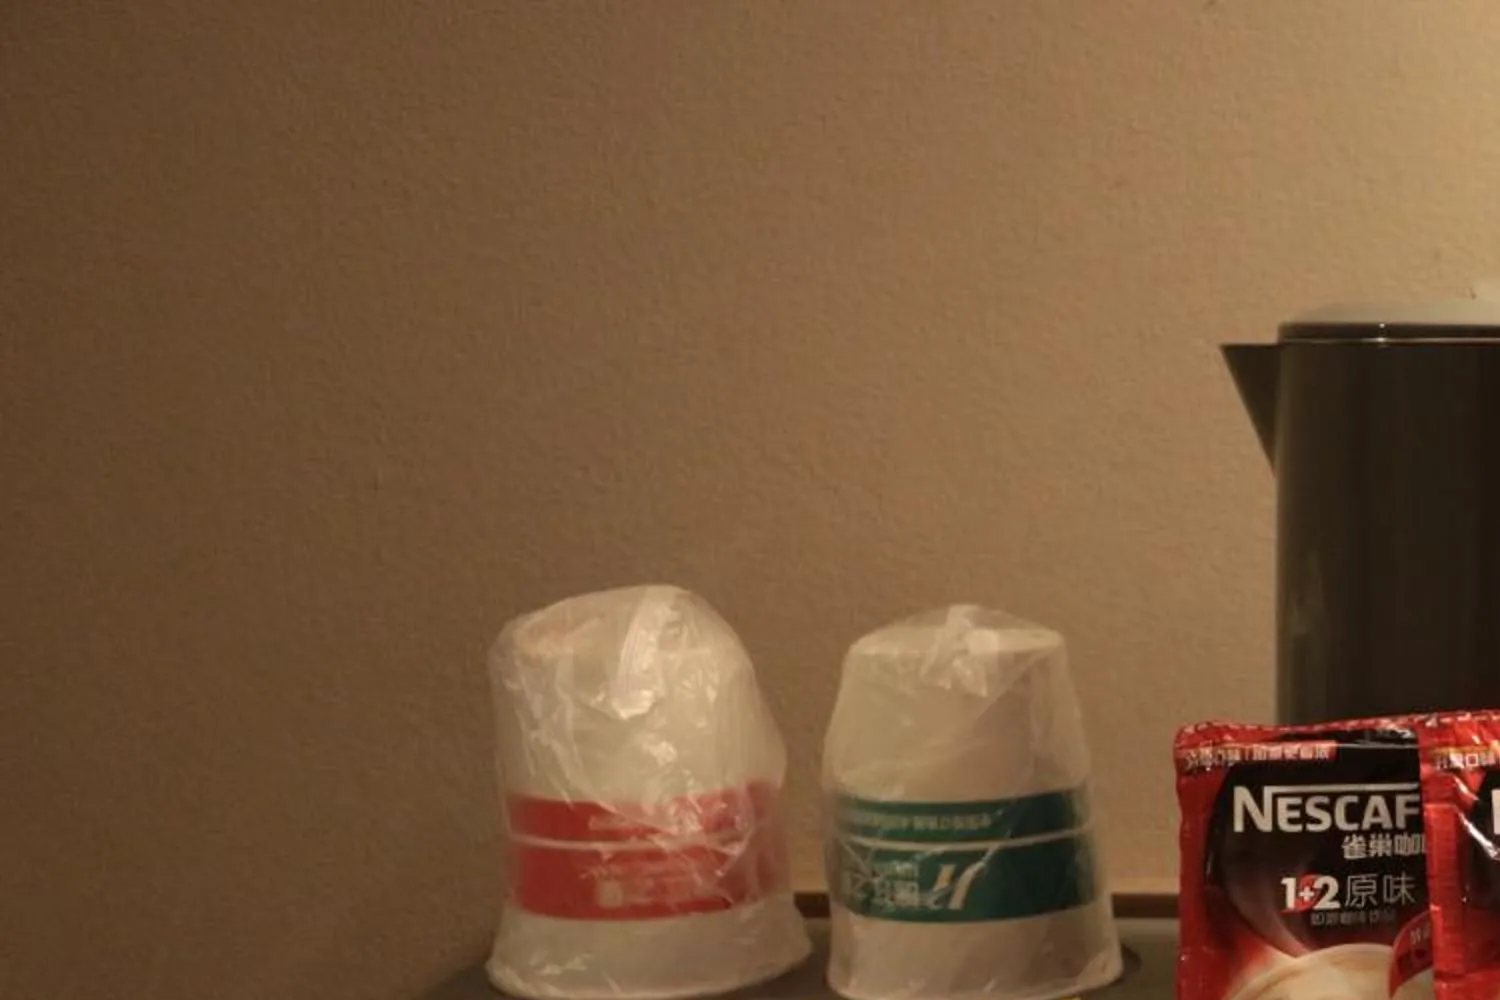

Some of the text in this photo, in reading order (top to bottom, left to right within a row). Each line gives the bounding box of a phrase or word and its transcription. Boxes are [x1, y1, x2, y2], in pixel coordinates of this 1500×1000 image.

[1233, 783, 1421, 833] NESCAF
[1341, 834, 1425, 860] 雀巢咖
